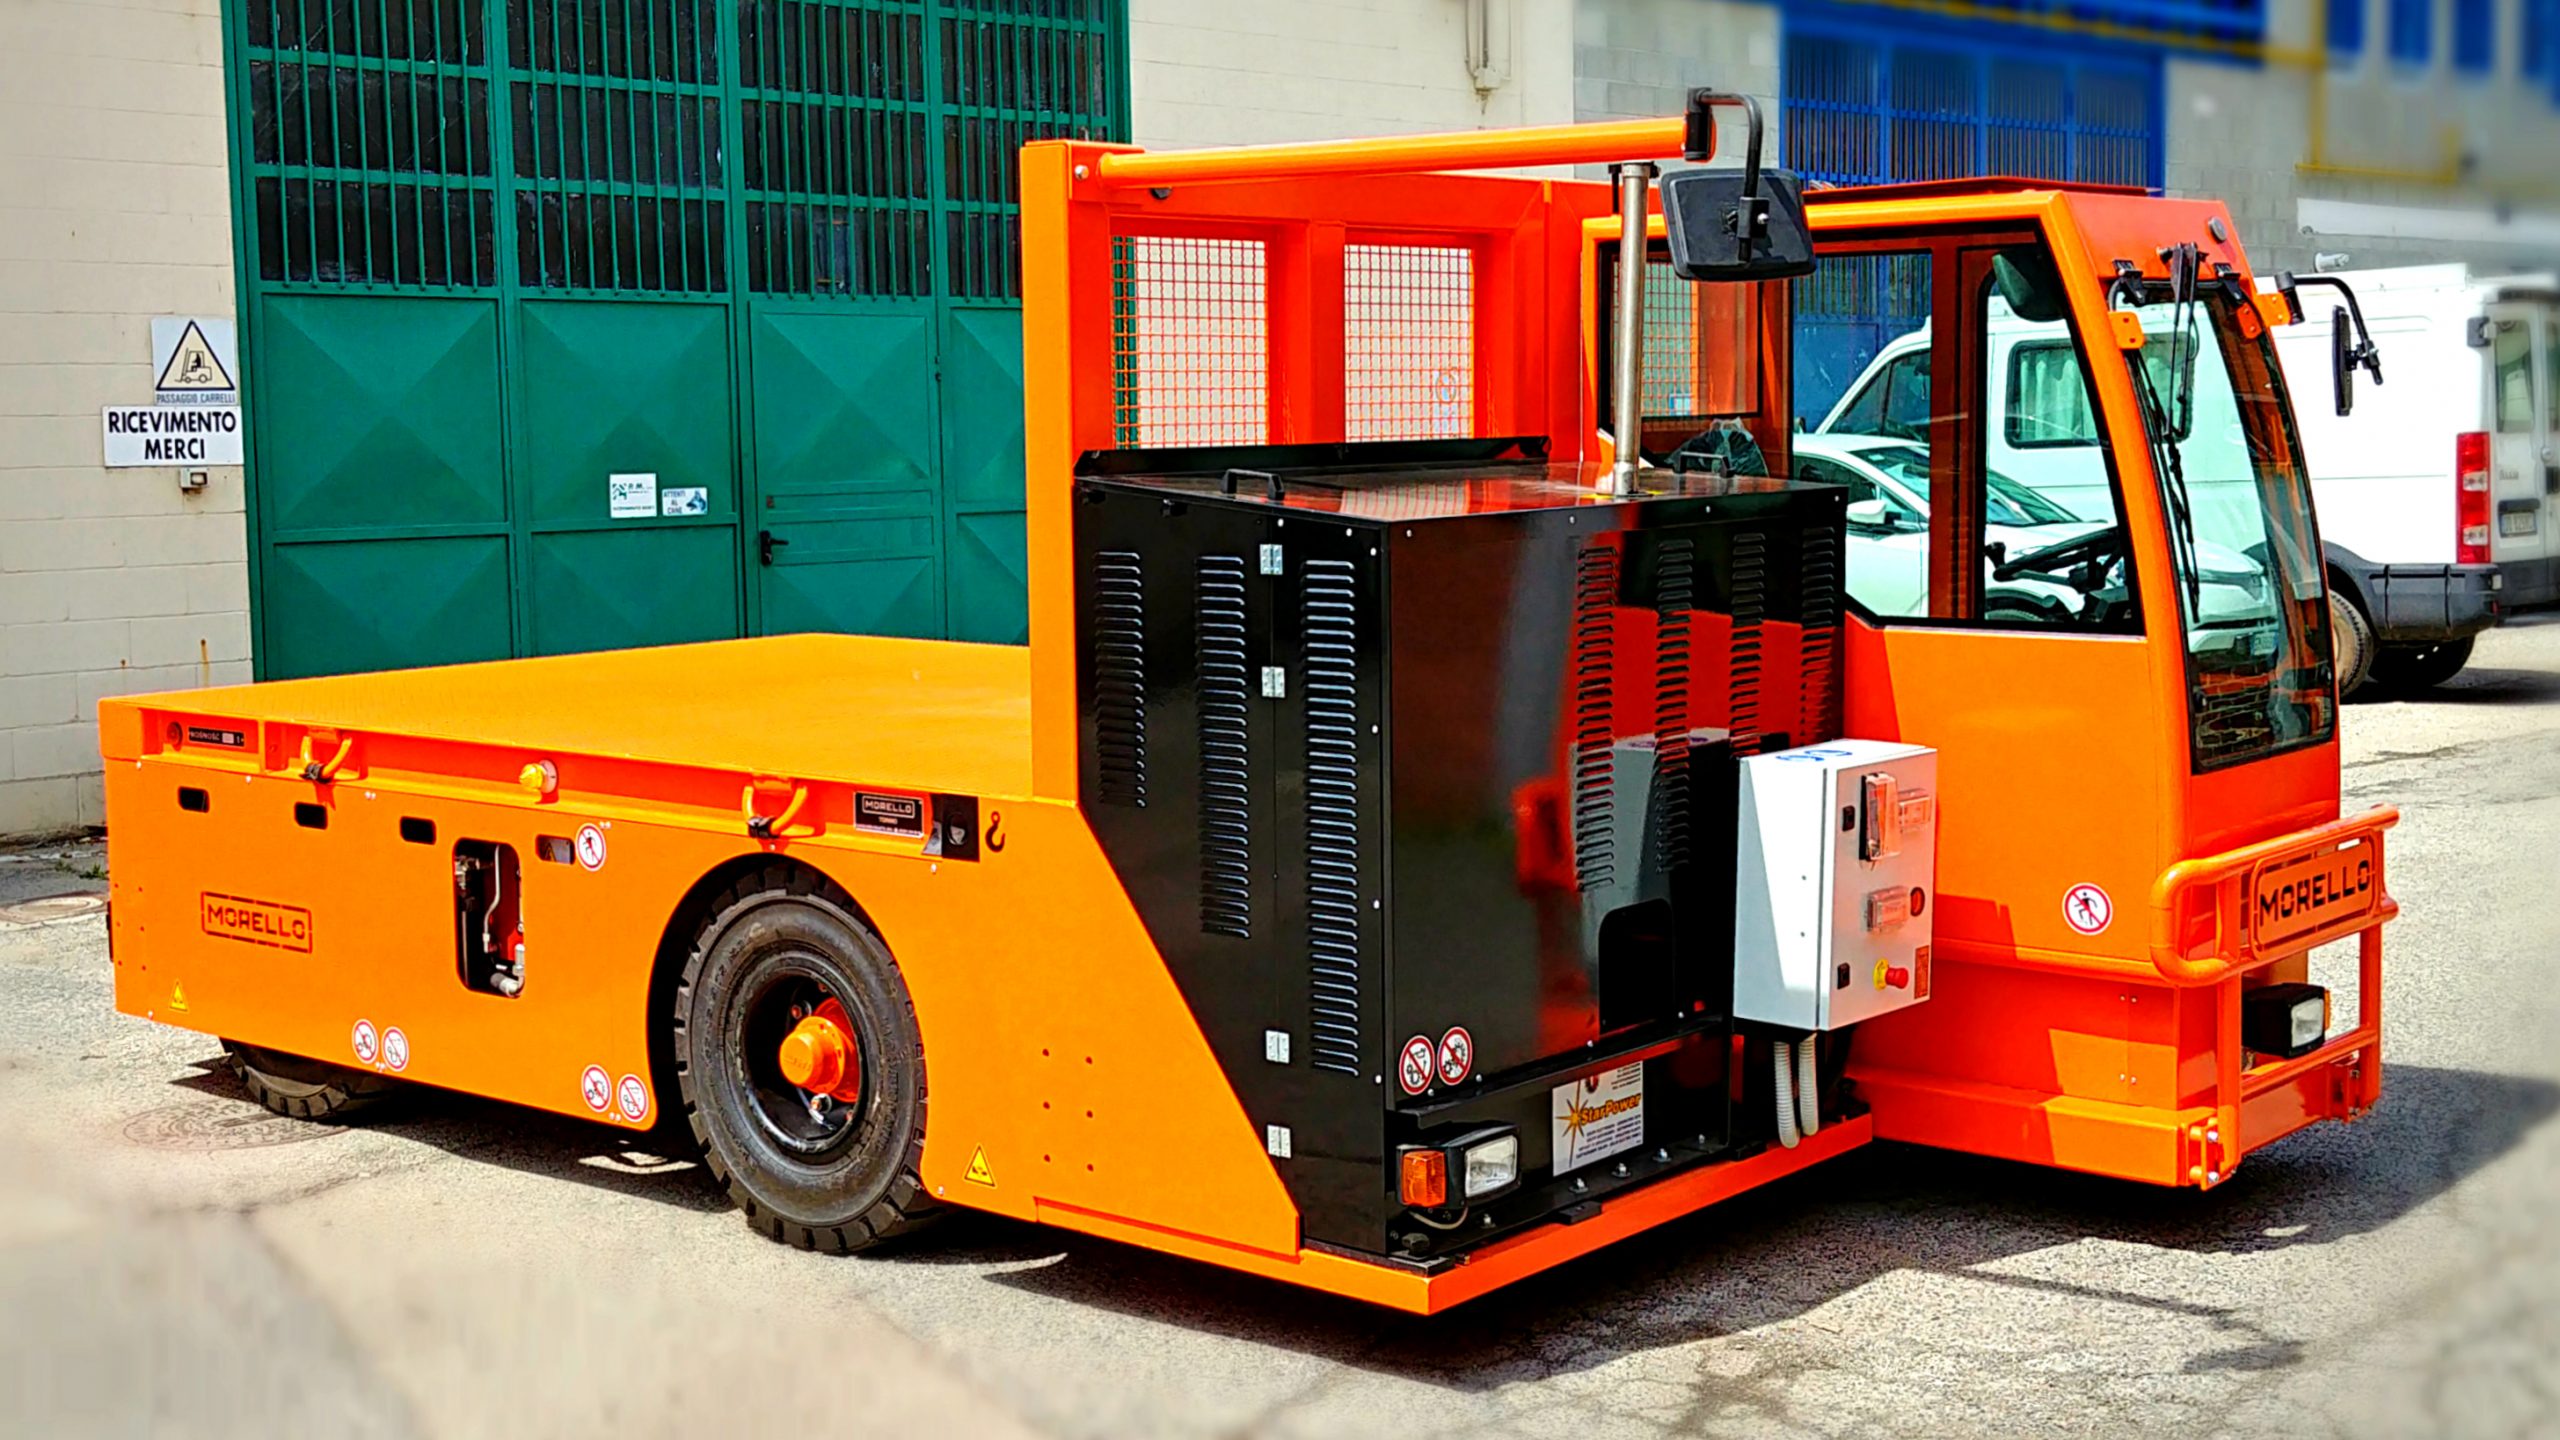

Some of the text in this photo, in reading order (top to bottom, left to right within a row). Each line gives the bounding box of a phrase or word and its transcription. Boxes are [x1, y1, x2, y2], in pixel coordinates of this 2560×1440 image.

[156, 393, 236, 404] PASSAGGIO CARRELLI
[108, 411, 236, 433] RICEVIMENTO
[144, 438, 205, 460] MERCI
[664, 490, 686, 498] ATTENTI
[864, 800, 912, 813] MORELLO
[2259, 859, 2370, 927] MORELLO
[207, 903, 305, 940] MORELLO
[1581, 1092, 1641, 1126] StarPower
